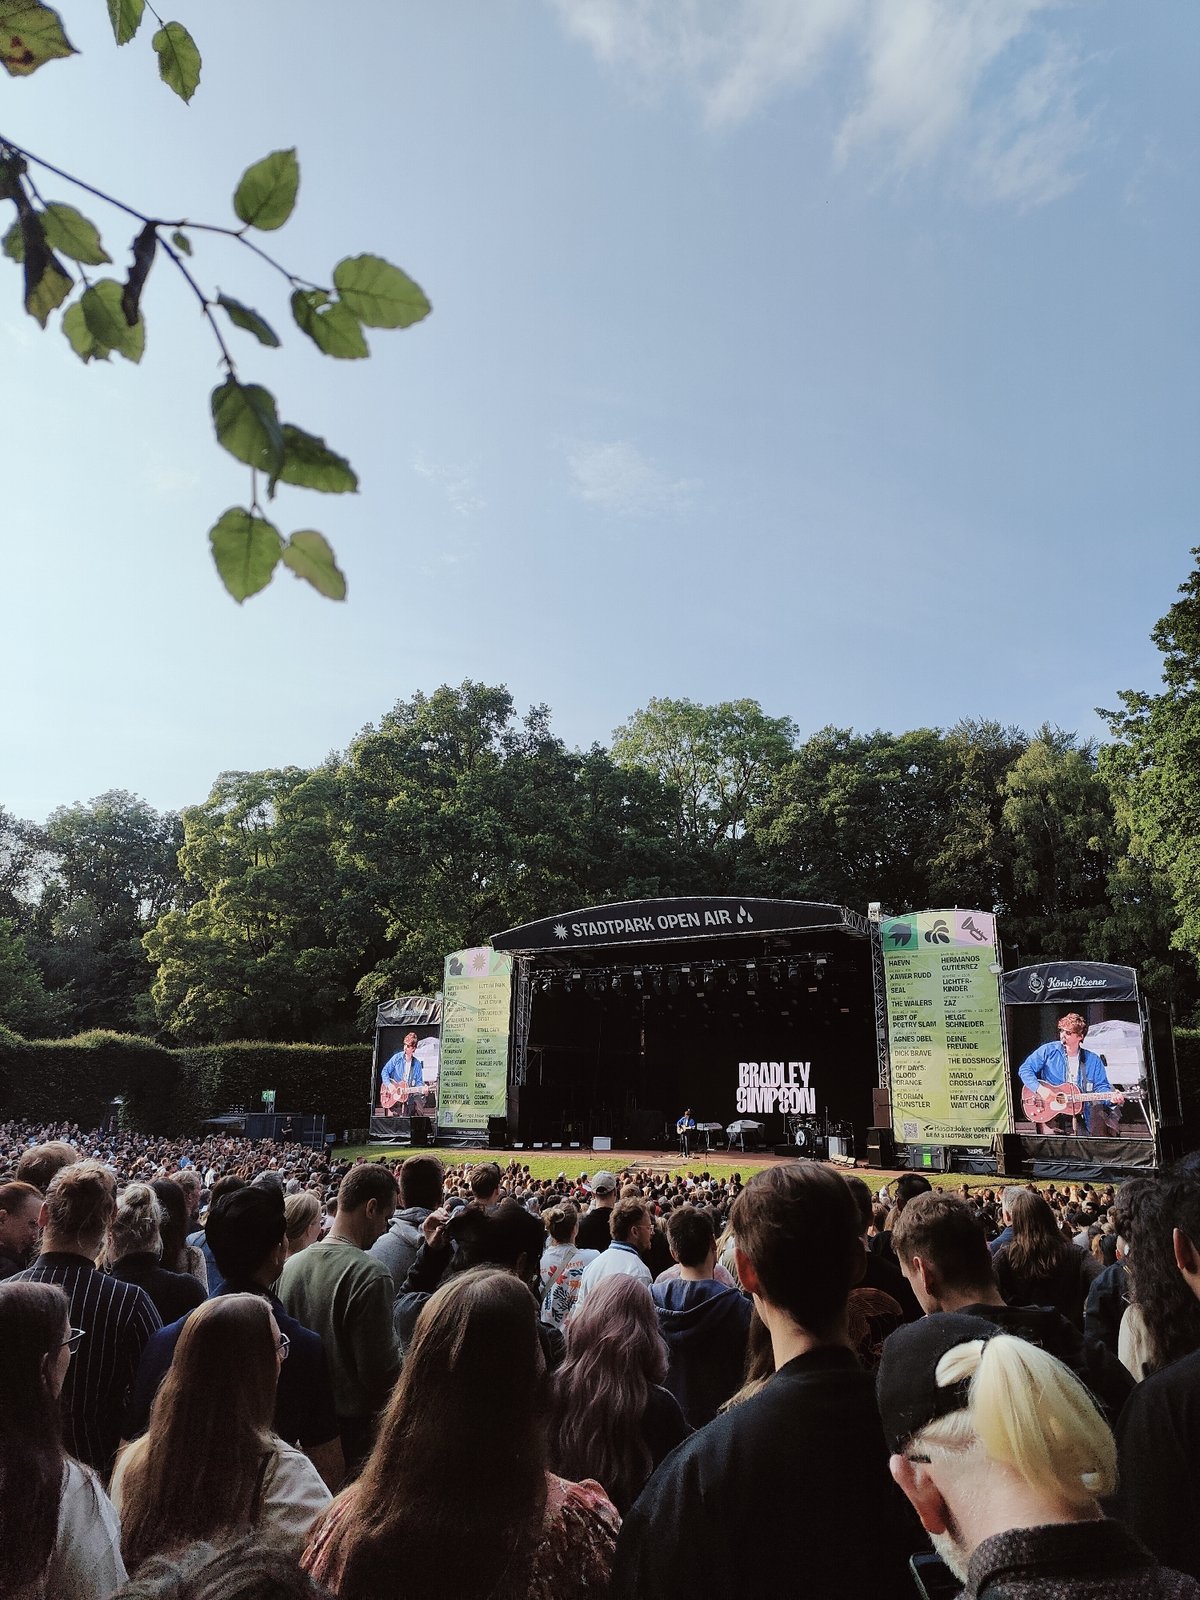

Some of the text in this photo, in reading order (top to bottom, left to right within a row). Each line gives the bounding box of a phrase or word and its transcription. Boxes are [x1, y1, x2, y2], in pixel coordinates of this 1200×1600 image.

[571, 909, 732, 937] STADTPARK OPEN AIR
[941, 956, 980, 964] HERMANOS
[1047, 976, 1107, 989] König Pilsener
[738, 1062, 811, 1088] BRADLEY
[736, 1087, 816, 1114] SIMPSON
